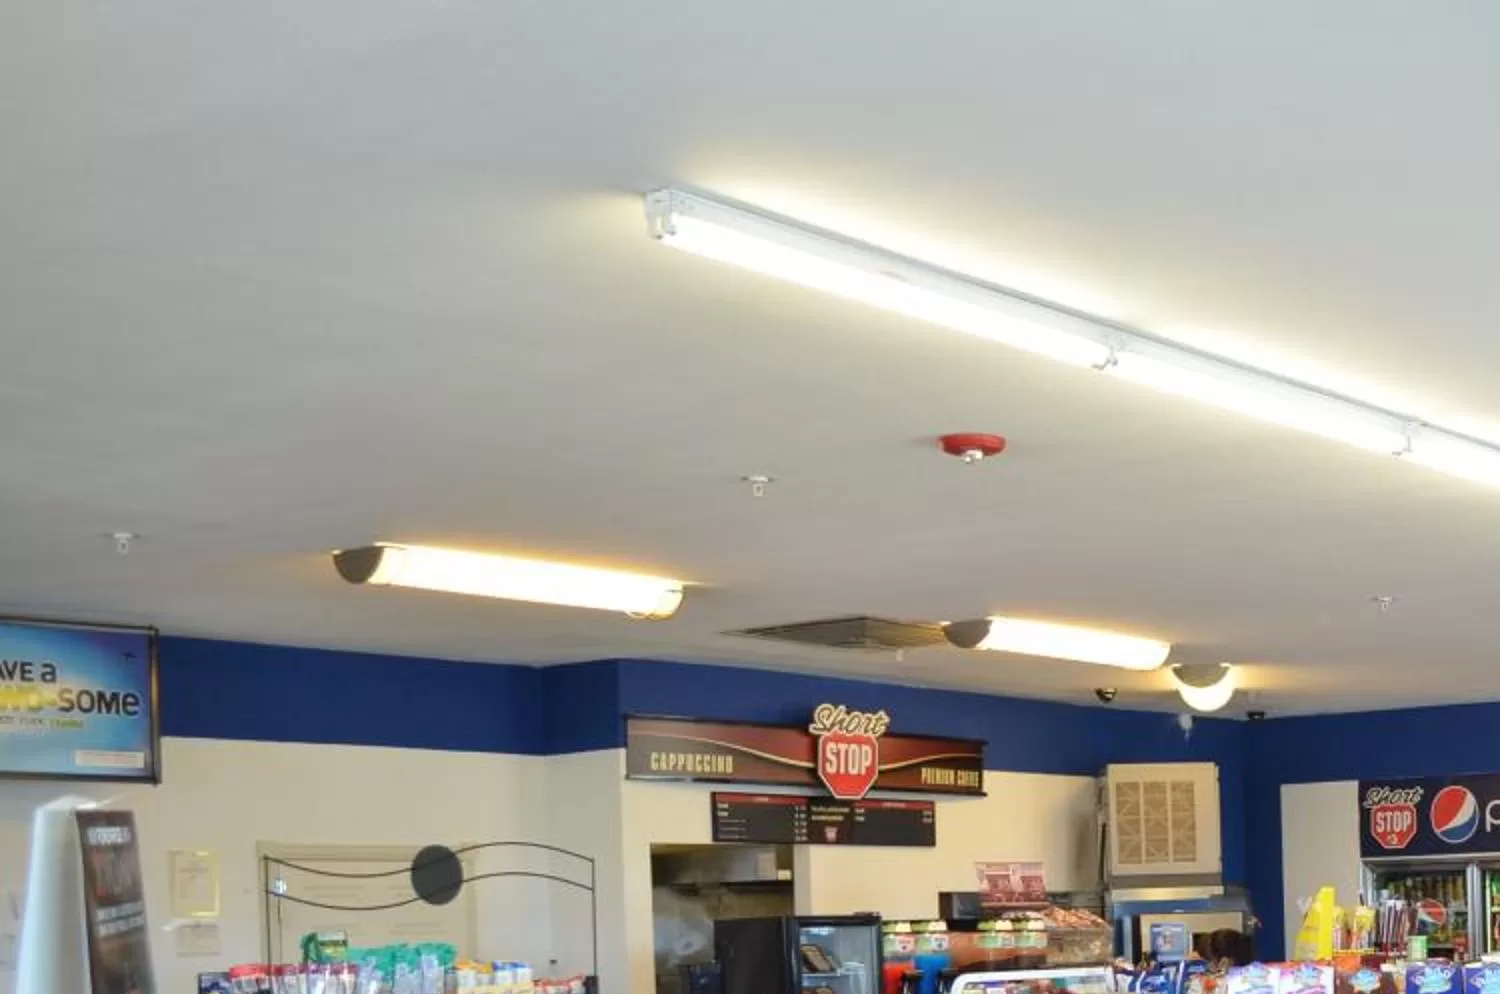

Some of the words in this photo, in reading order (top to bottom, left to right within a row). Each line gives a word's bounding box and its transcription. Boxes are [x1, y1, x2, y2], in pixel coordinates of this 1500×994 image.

[809, 703, 891, 736] Short
[651, 751, 734, 774] CAPPUCCINO
[825, 741, 873, 775] STOP
[1364, 786, 1424, 809] Short
[1376, 810, 1412, 833] STOP
